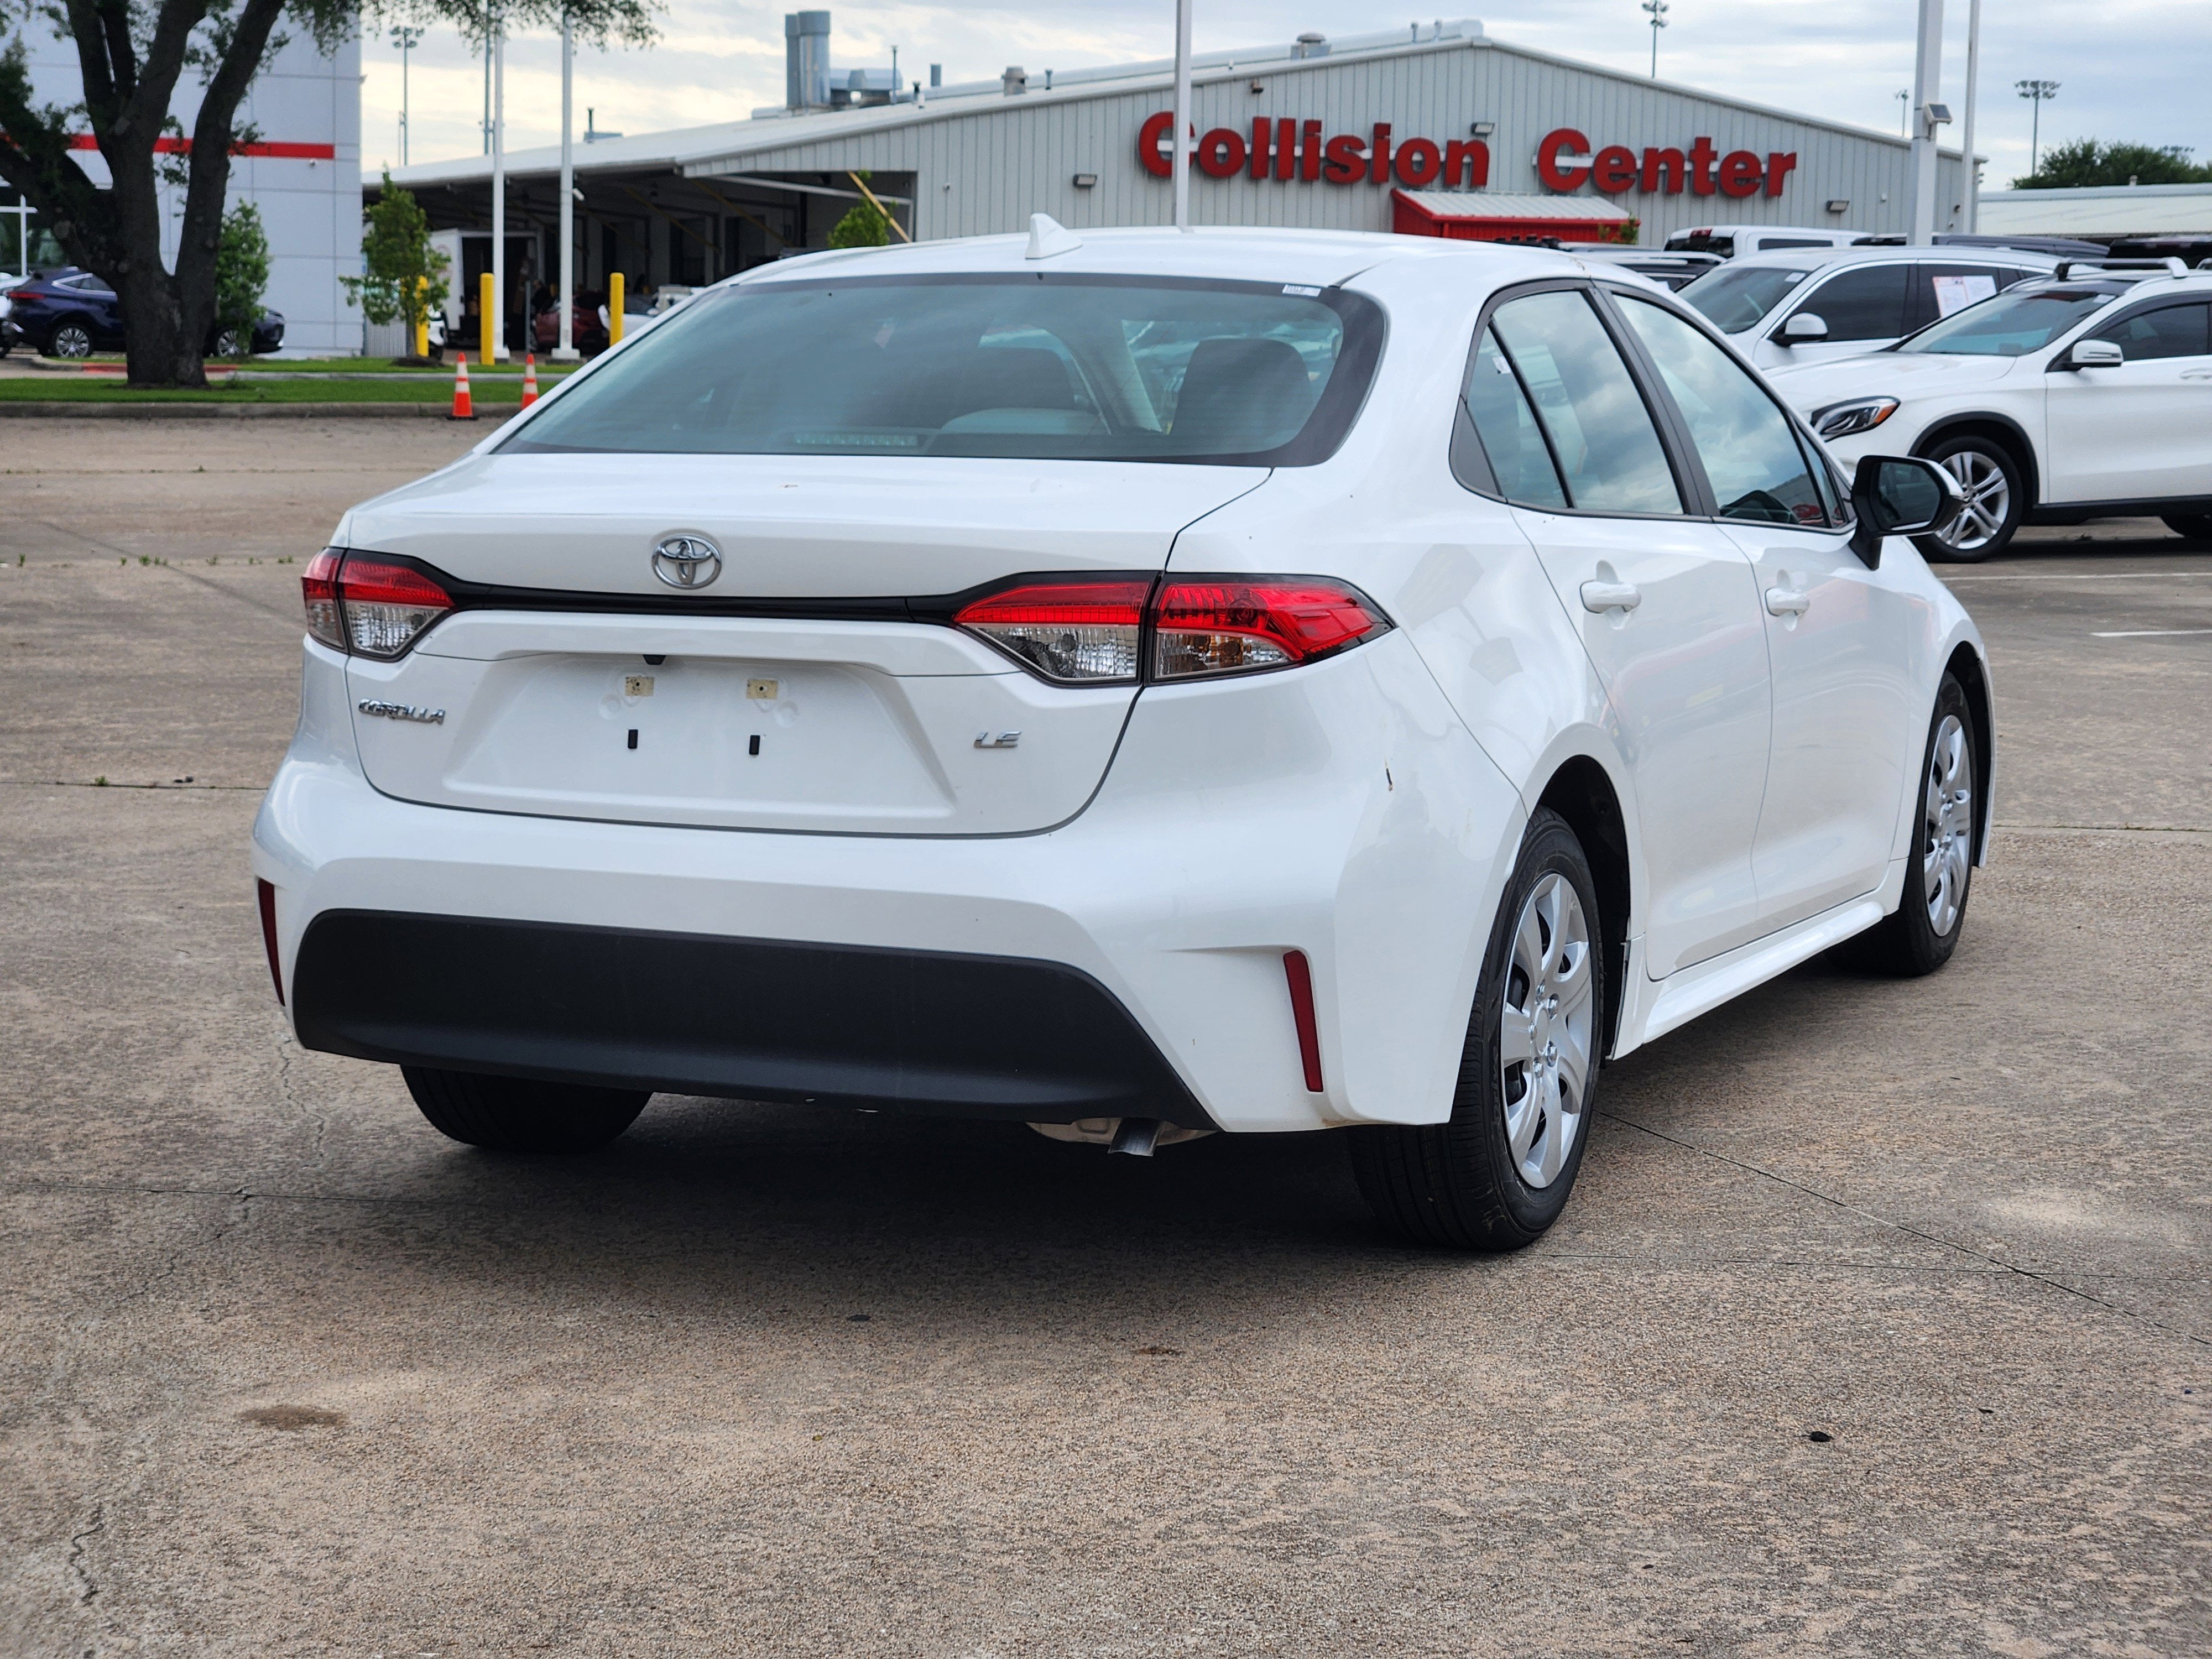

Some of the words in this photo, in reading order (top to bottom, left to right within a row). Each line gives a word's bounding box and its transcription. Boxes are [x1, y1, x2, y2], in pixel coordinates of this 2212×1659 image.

[1138, 111, 1490, 188] Collision
[1537, 127, 1797, 198] Center
[358, 698, 446, 725] COROLLA
[973, 731, 1022, 749] LE
